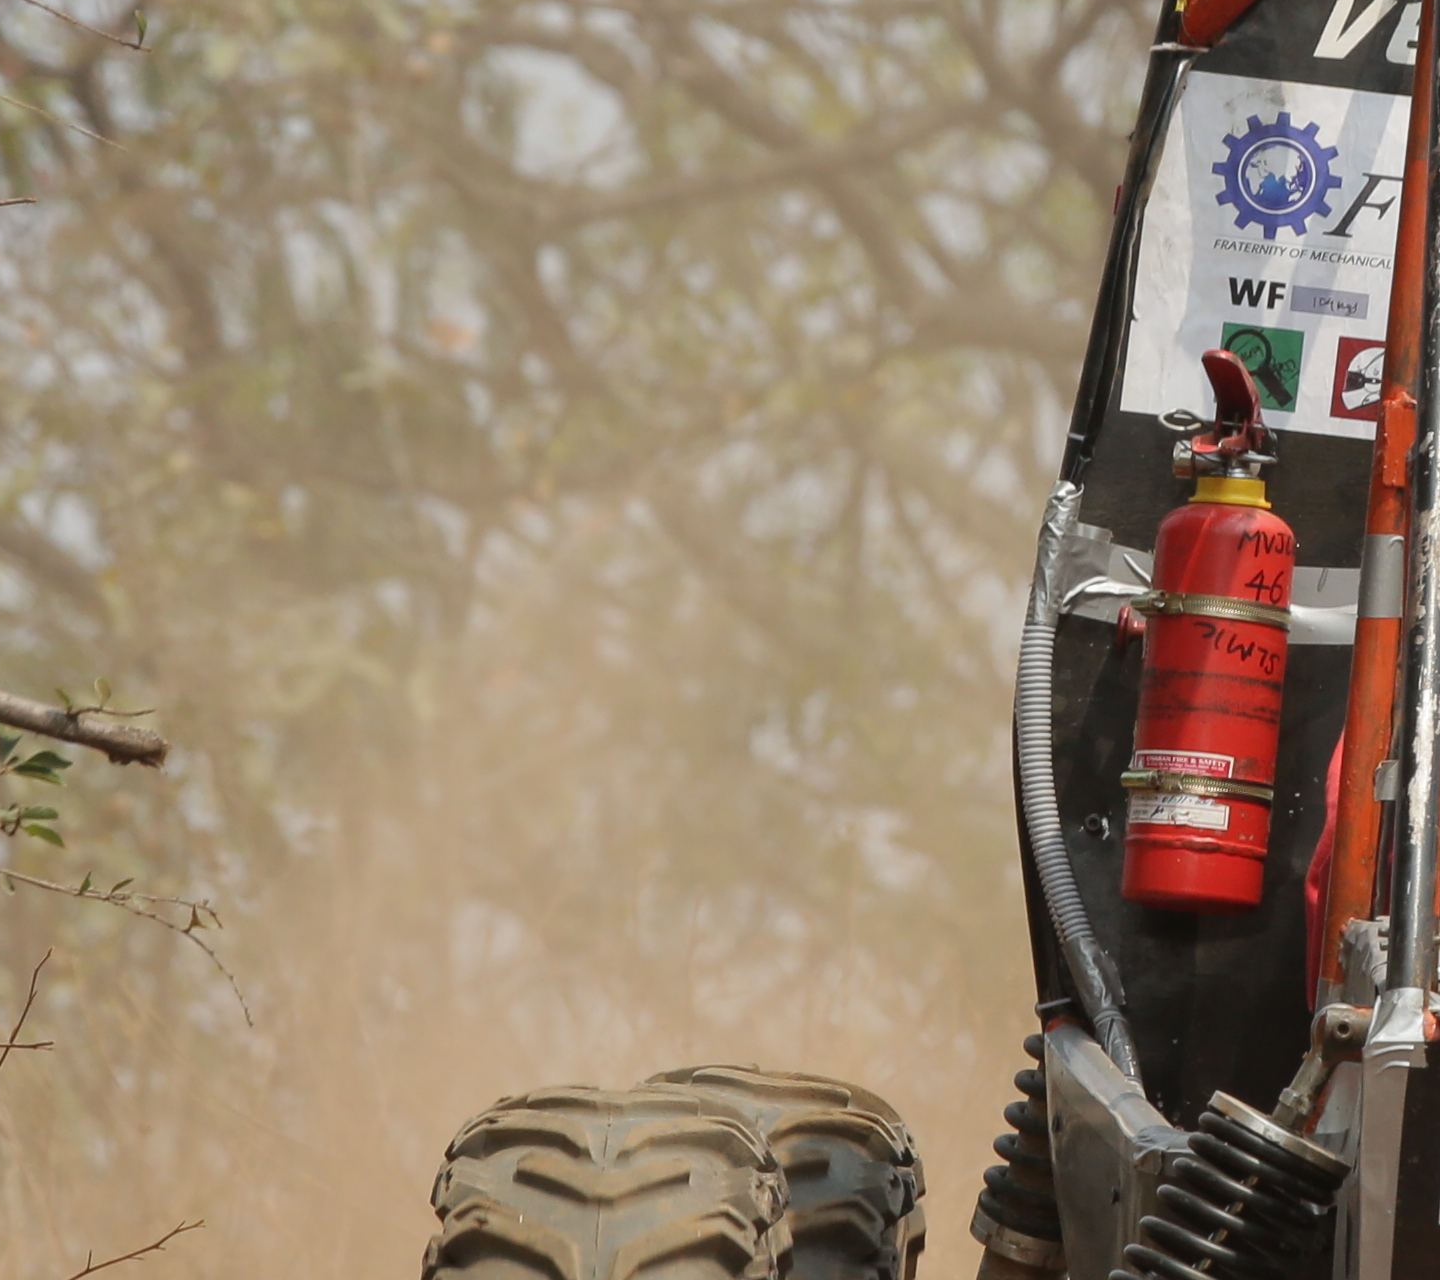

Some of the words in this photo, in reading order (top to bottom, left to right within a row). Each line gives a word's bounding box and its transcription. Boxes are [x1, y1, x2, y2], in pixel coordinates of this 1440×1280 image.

[1213, 239, 1287, 257] FRATERNITY
[1289, 248, 1309, 259] OF
[1310, 250, 1392, 269] MECHANICAL
[1228, 277, 1287, 310] WF
[1245, 569, 1285, 605] 46
